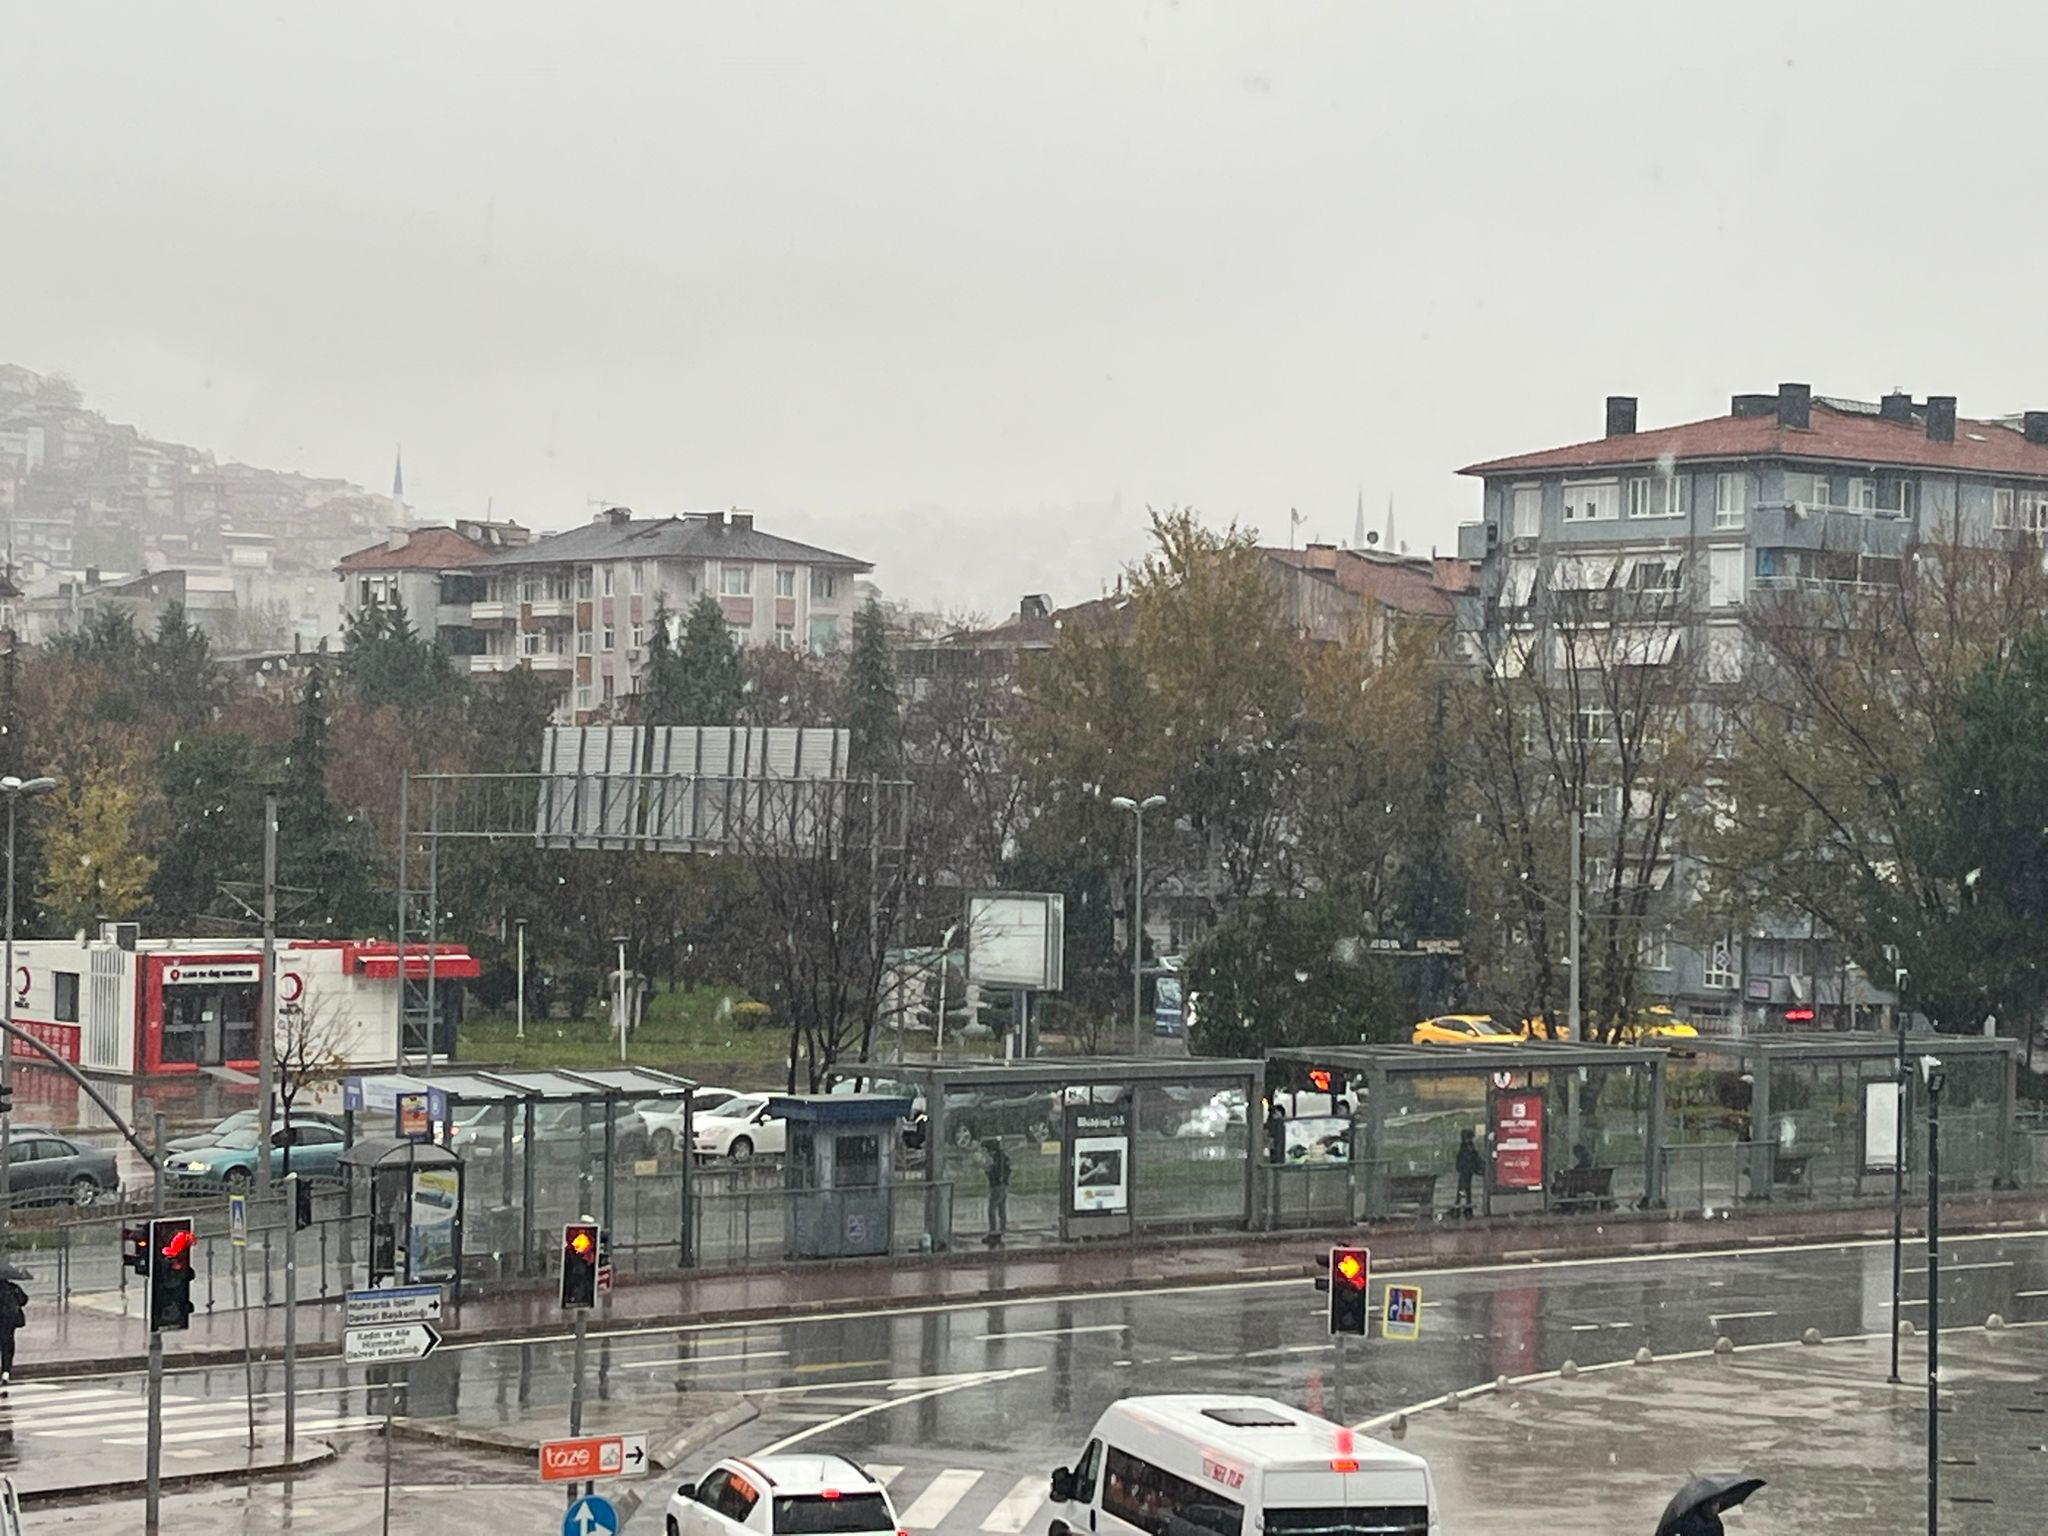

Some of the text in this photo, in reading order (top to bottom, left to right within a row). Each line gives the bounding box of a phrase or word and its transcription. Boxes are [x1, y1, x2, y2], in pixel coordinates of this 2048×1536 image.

[349, 1309, 427, 1323] Dairesi Başkanlığı
[357, 1331, 381, 1341] Kadın
[347, 1346, 420, 1359] Dairesi Başkanlığı
[545, 1447, 591, 1468] taze
